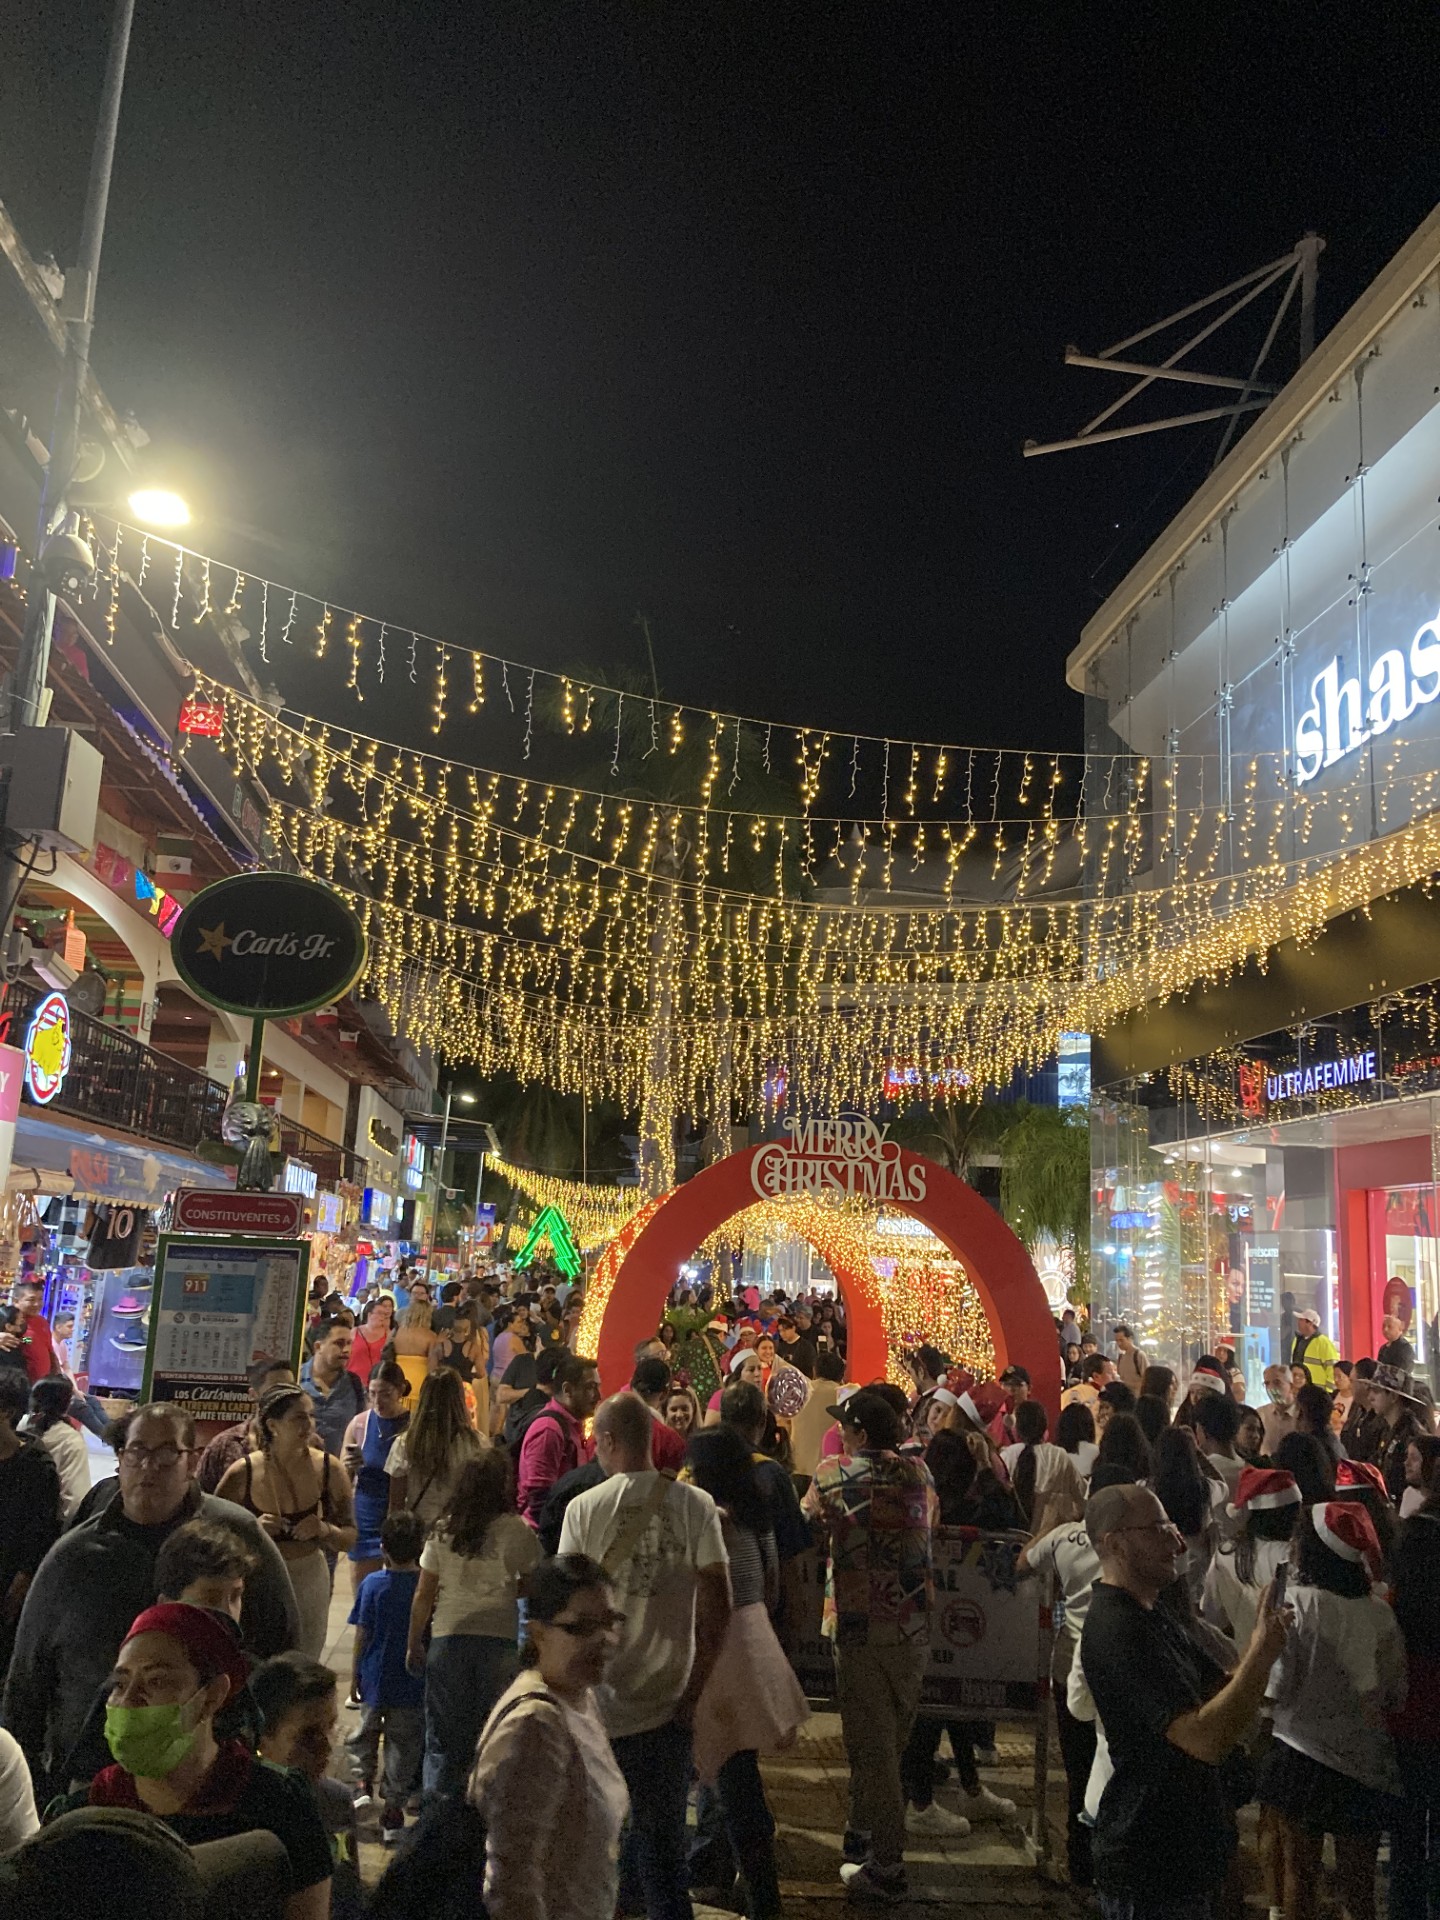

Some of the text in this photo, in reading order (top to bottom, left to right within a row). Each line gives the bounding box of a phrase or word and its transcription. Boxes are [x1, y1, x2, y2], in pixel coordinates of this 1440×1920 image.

[231, 929, 336, 960] Carl's Jr.
[1267, 1051, 1376, 1101] ULTRAFEMME
[782, 1112, 901, 1164] MERRY
[751, 1143, 927, 1207] CHRISTMAS
[106, 1208, 135, 1240] 10
[186, 1208, 291, 1225] CONSTITUYENTES A
[185, 1277, 208, 1292] 911
[174, 1389, 190, 1399] LOS
[181, 1401, 220, 1411] ATREVEN
[220, 1401, 227, 1411] A
[228, 1402, 249, 1412] CAER
